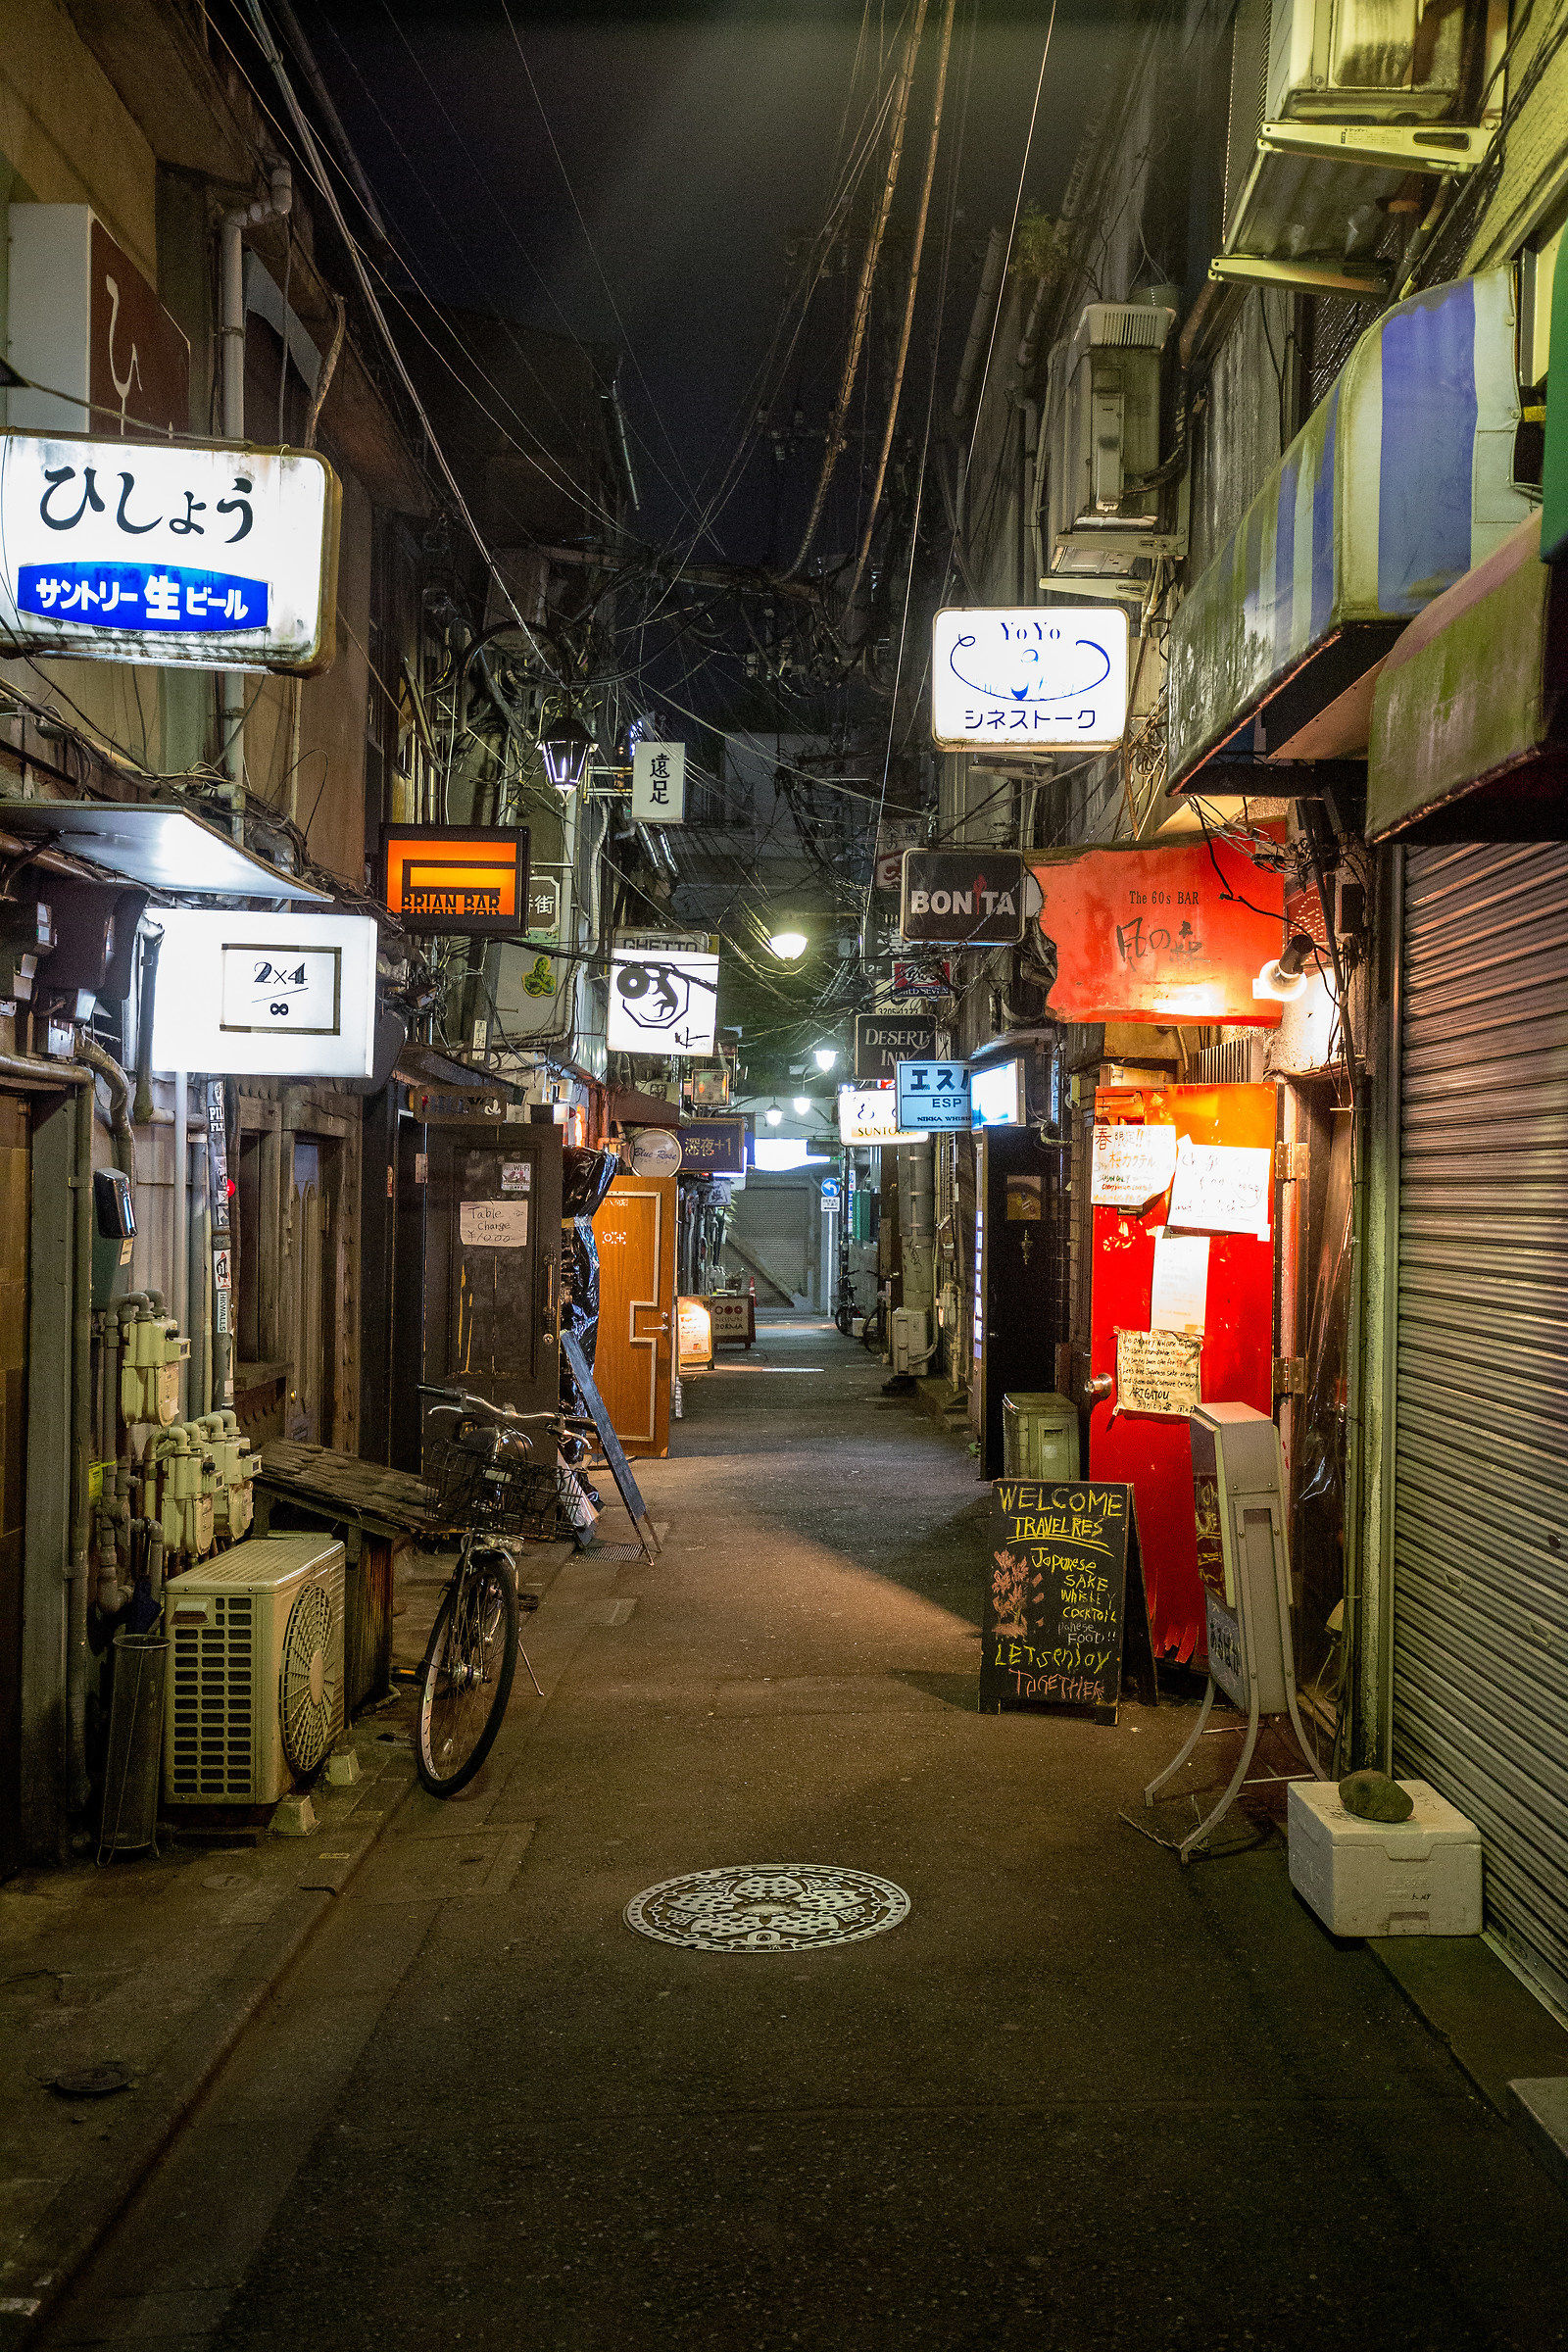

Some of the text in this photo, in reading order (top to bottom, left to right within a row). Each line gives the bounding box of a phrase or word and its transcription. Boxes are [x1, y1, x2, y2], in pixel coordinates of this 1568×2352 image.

[39, 466, 254, 544] ひしょう
[35, 574, 249, 621] サントリー生ビール
[1000, 621, 1061, 641] YoYo
[964, 710, 1097, 729] シネストーク
[650, 753, 670, 805] 遠足
[402, 894, 500, 915] BRIAN BAR
[528, 894, 555, 915] 街
[1129, 890, 1200, 906] The 60s BAR
[865, 1029, 930, 1050] DESERT
[932, 1098, 961, 1108] ESP
[468, 1206, 502, 1219] Table
[477, 1221, 512, 1231] Charge
[997, 1484, 1123, 1517] WELCOME
[1063, 1573, 1108, 1592] SAKE
